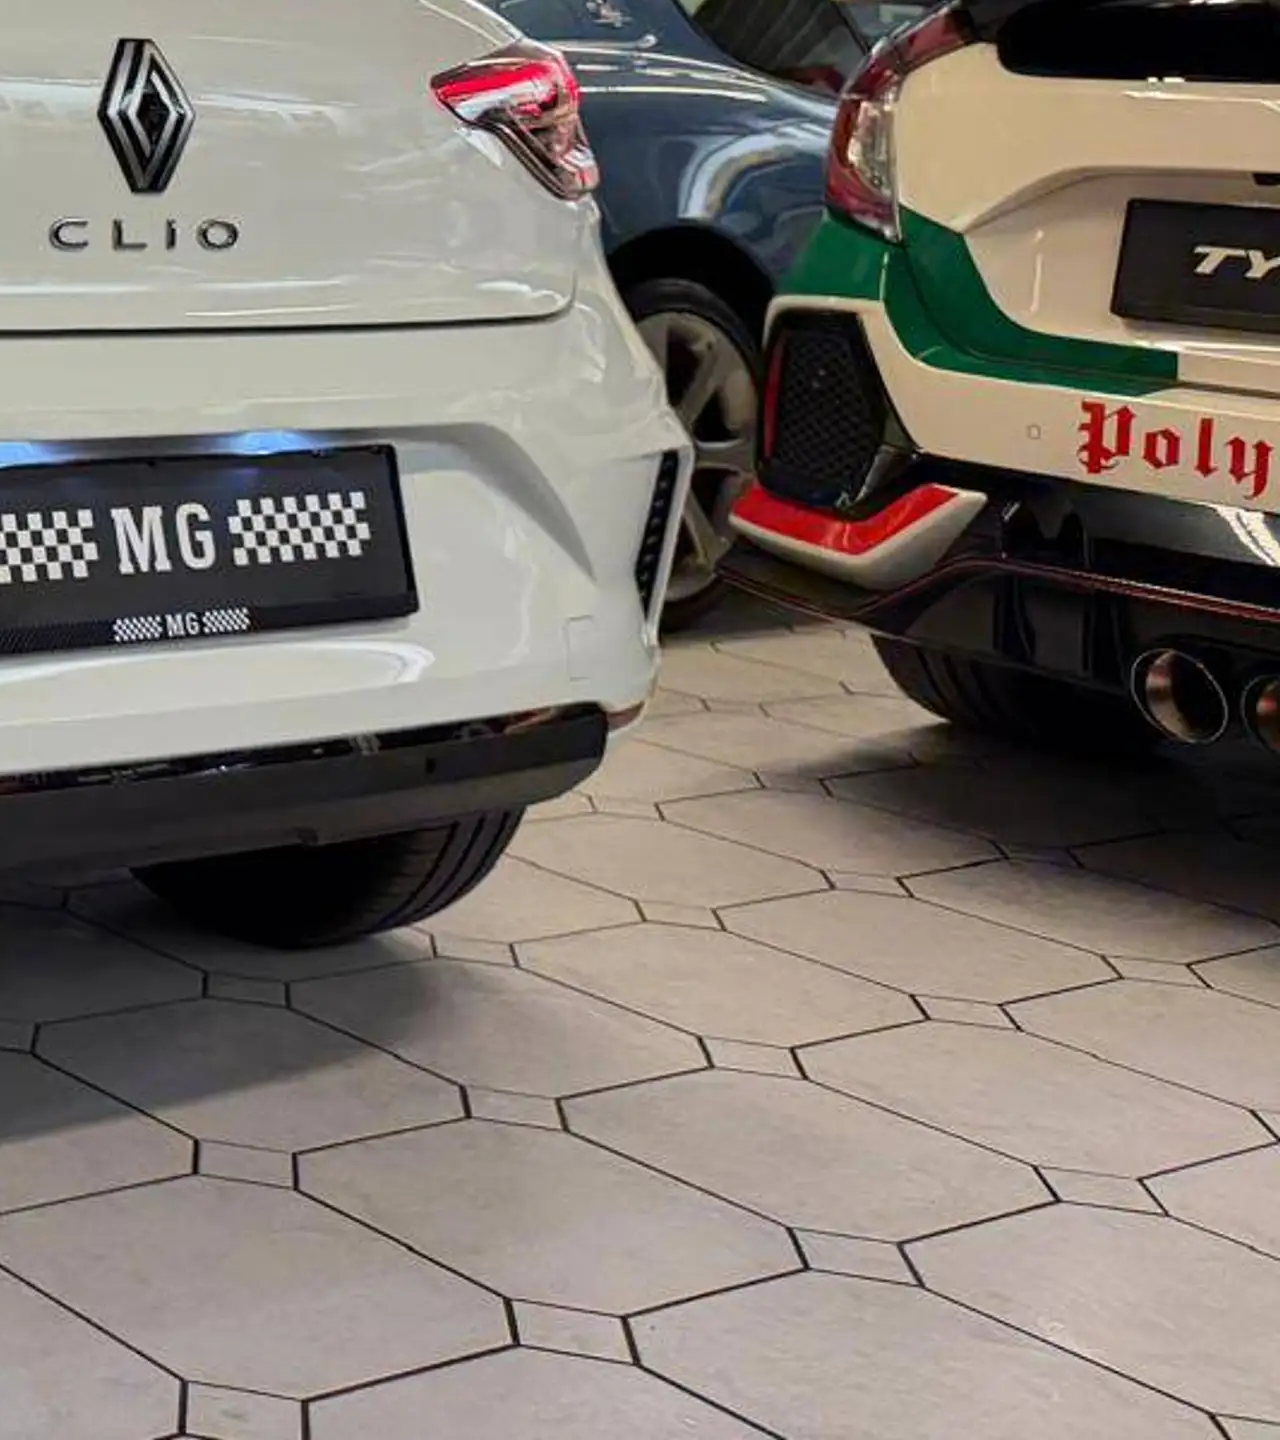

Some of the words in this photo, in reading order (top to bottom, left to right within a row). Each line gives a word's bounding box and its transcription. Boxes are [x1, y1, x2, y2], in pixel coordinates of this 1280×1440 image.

[48, 216, 240, 252] CLIO
[1076, 398, 1273, 501] Poly
[110, 502, 217, 576] MG
[165, 611, 200, 637] MG
